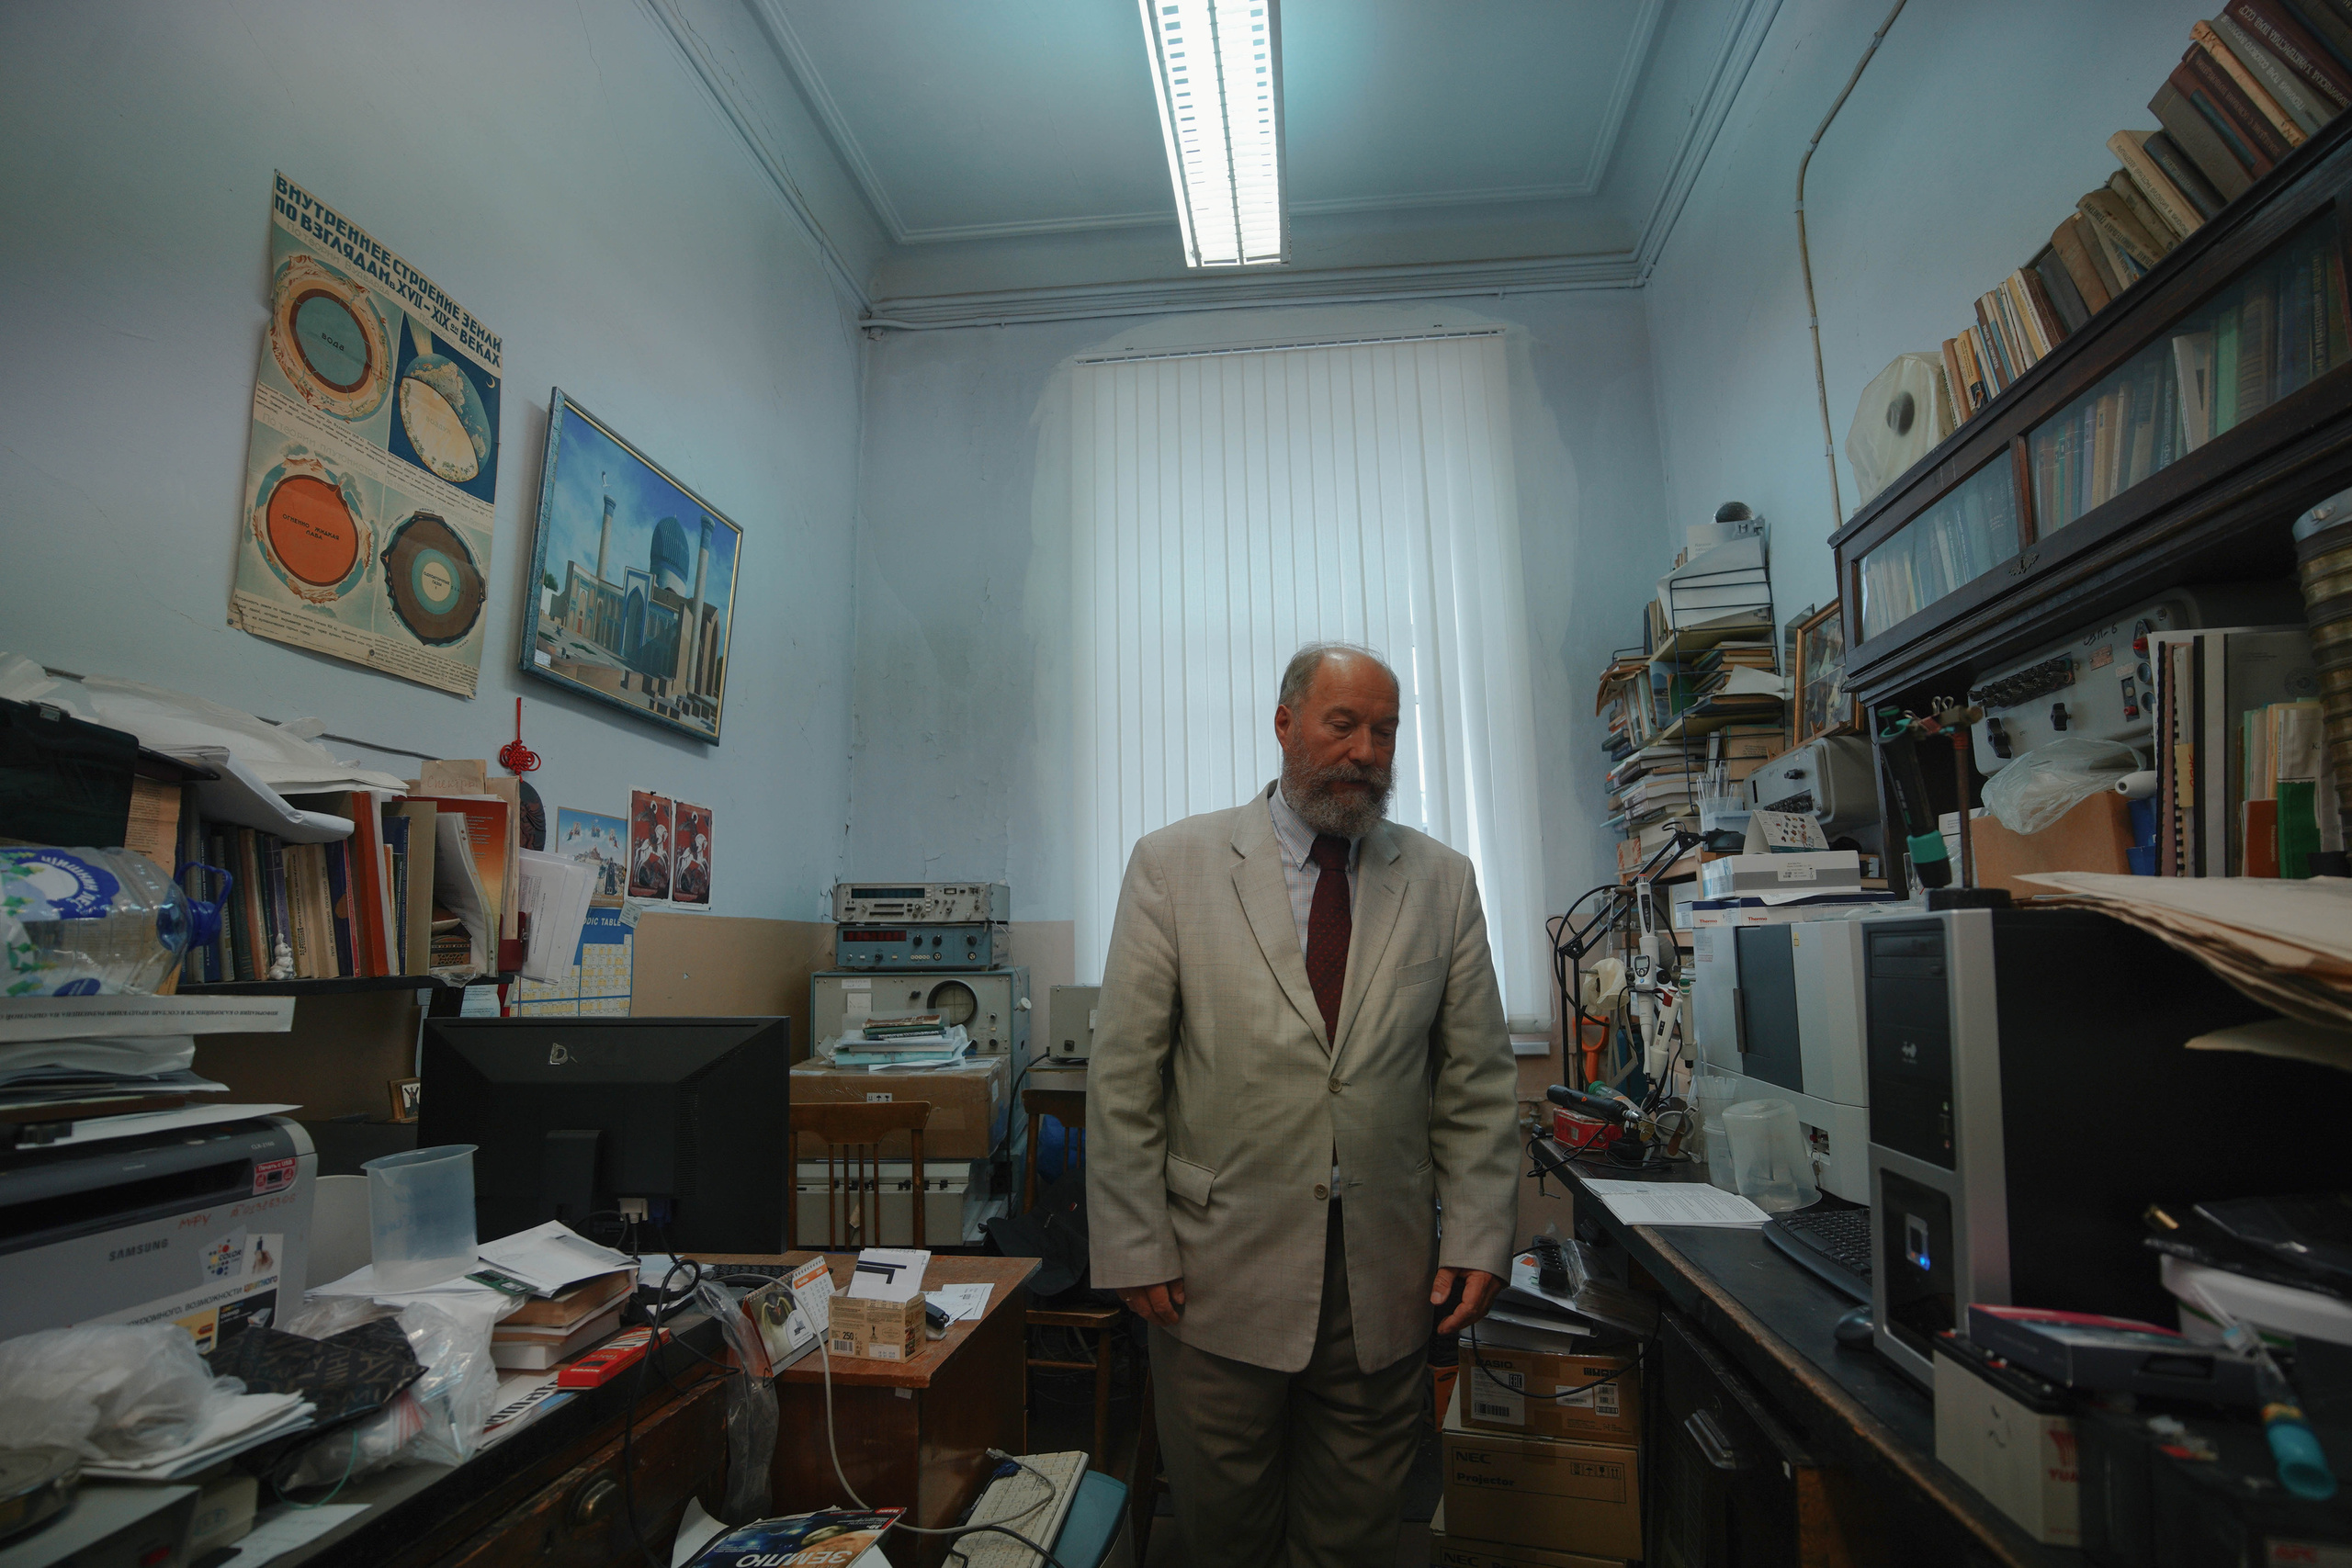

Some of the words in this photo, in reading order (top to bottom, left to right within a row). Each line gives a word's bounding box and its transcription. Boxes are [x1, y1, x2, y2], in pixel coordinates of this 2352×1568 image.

[2238, 4, 2257, 22] СССР
[2252, 17, 2271, 35] ПОЧВ
[2242, 40, 2270, 70] СОДОВОГО
[2265, 66, 2282, 83] ПОЧВ
[2277, 80, 2307, 110] ГЕОХИМИЯ
[2149, 186, 2170, 209] БИОЛОГИЯ
[276, 169, 390, 271] ВНУТРЕННЕЕ
[392, 255, 460, 321] СТРОЕНИЕ
[461, 310, 501, 353] ЗЕМЛИ
[274, 192, 298, 223] ПО
[300, 209, 390, 288] ВЗГЛЯДАМ
[458, 326, 501, 369] ВЕКАХ
[282, 512, 310, 529] ОГНЕННО
[314, 525, 339, 541] ЖИДКАЯ
[305, 528, 322, 540] ЛАВА
[601, 918, 621, 927] TABLE
[257, 1163, 276, 1172] Печать
[108, 1238, 169, 1262] SAMSUNG
[218, 1249, 243, 1260] COLOR
[186, 1288, 243, 1312] ВОЗМОЖНОСТИ
[243, 1275, 278, 1292] ЦВЕТНОГО
[842, 1332, 854, 1341] 250
[1456, 1451, 1492, 1464] NEC
[1457, 1472, 1515, 1486] Projector
[735, 1551, 853, 1567] ЗЕМЛЮ
[1443, 1552, 1479, 1567] NEC
